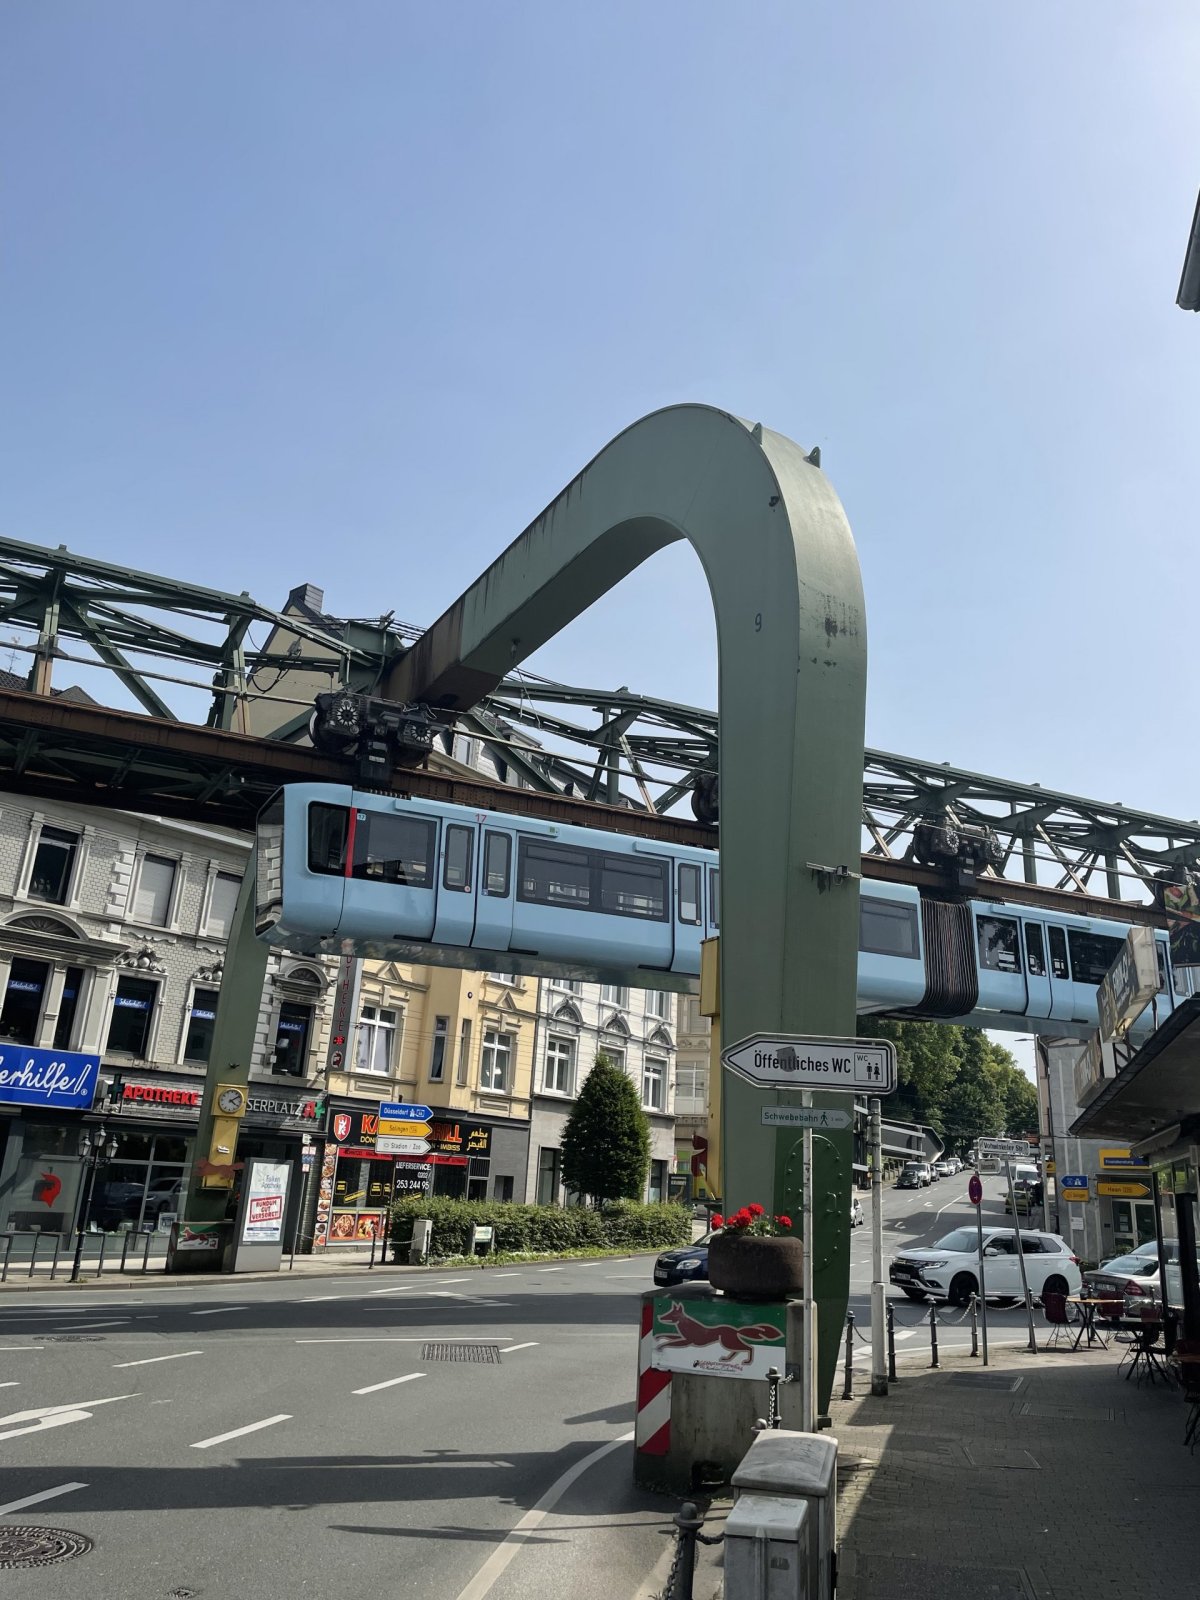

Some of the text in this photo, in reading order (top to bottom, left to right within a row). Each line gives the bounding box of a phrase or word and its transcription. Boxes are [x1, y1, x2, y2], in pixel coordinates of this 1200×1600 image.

[475, 813, 487, 823] 17
[754, 1049, 851, 1073] Öffentliches WC
[857, 1054, 868, 1062] WC
[122, 1084, 199, 1106] APOTHEKE
[246, 1098, 302, 1117] SERPLATZ
[383, 1107, 409, 1117] Düsseldorf
[764, 1111, 819, 1122] Schwebebahn
[389, 1124, 408, 1133] Solingen
[390, 1142, 408, 1150] Stadion
[440, 1143, 461, 1152] IMBISS
[396, 1179, 408, 1189] 253
[408, 1180, 421, 1189] 244
[421, 1181, 431, 1190] 95
[256, 1199, 277, 1208] RUNDUM
